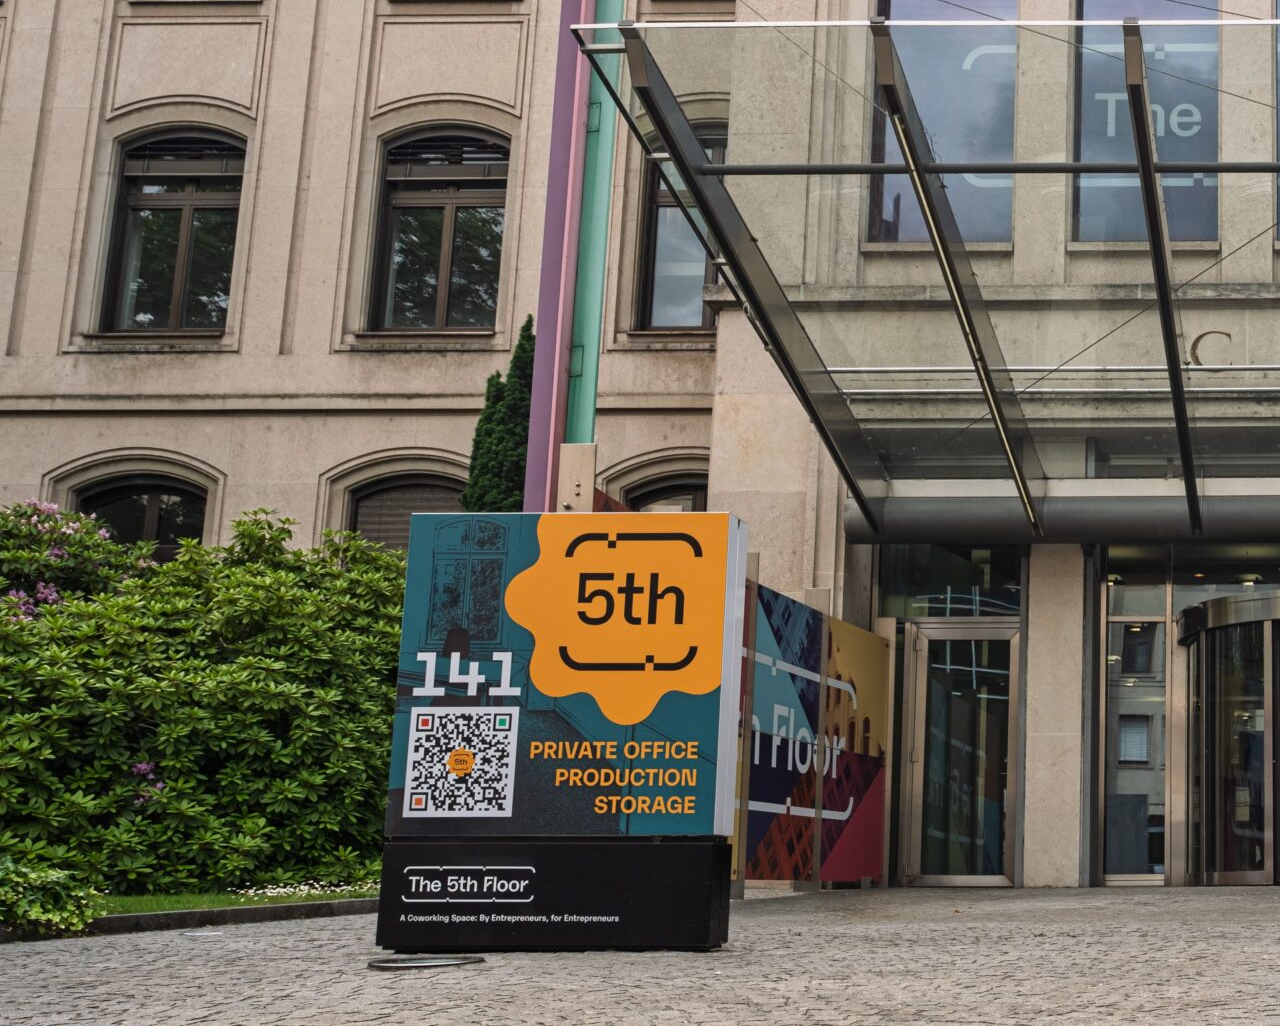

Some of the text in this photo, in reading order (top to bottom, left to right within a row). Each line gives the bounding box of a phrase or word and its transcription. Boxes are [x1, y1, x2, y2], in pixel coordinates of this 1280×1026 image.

[577, 572, 685, 626] 5th
[412, 651, 522, 696] 141
[529, 741, 699, 759] PRIVATE OFFICE
[771, 703, 847, 779] Floor
[454, 758, 468, 766] 5th
[554, 768, 697, 787] PRODUCTION
[594, 795, 697, 814] STORAGE
[408, 876, 529, 893] The 5th Floor
[399, 914, 620, 923] A Coworking Space: By Entrepreneurs, for Entrepreneurs
